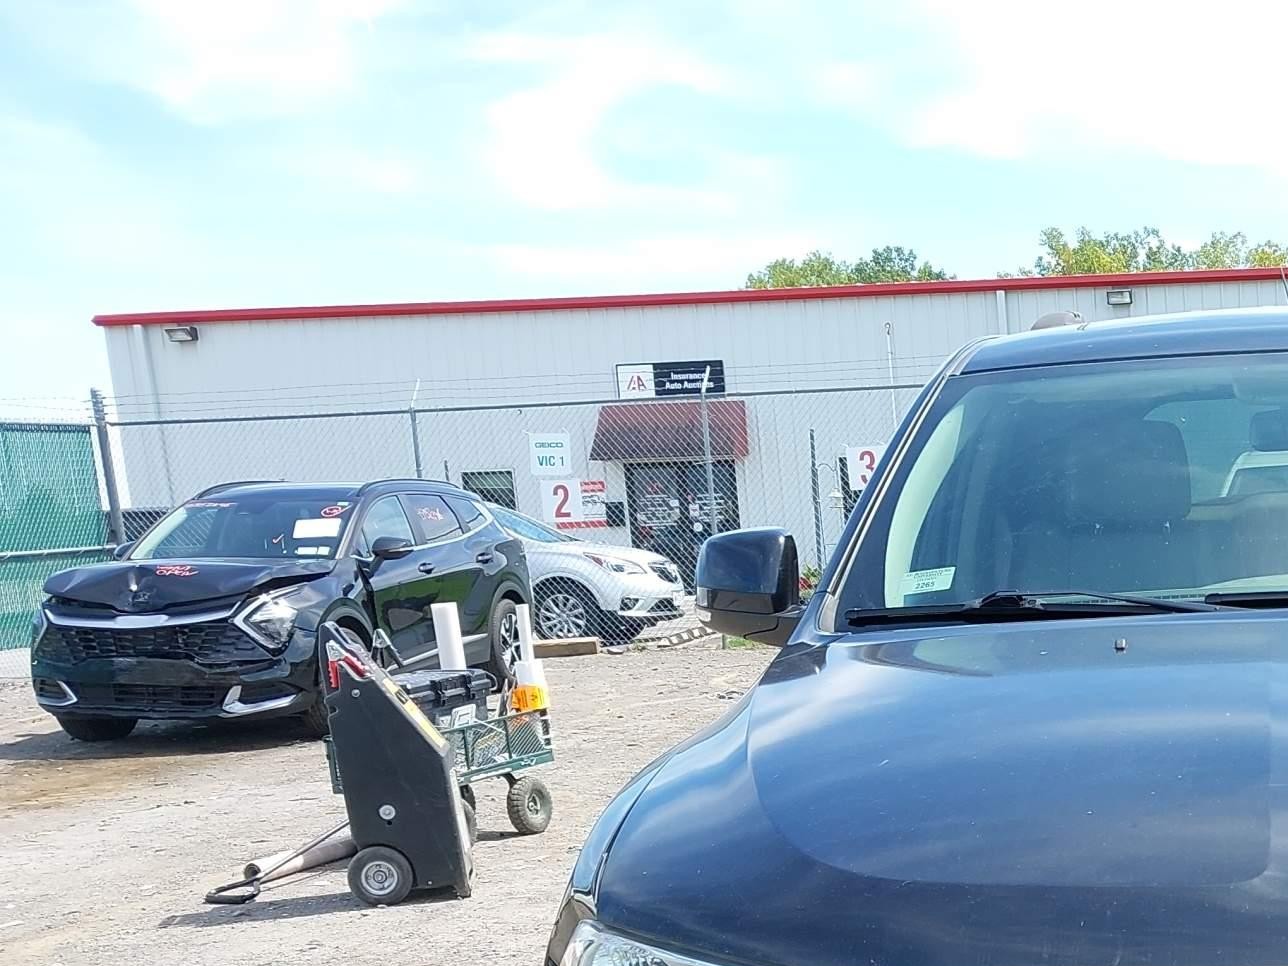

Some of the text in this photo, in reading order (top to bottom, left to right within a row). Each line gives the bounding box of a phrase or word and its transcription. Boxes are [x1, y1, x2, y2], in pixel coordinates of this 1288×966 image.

[665, 381, 681, 389] Auto
[537, 455, 564, 466] VIC 1
[859, 450, 875, 484] 3
[552, 484, 571, 517] 2
